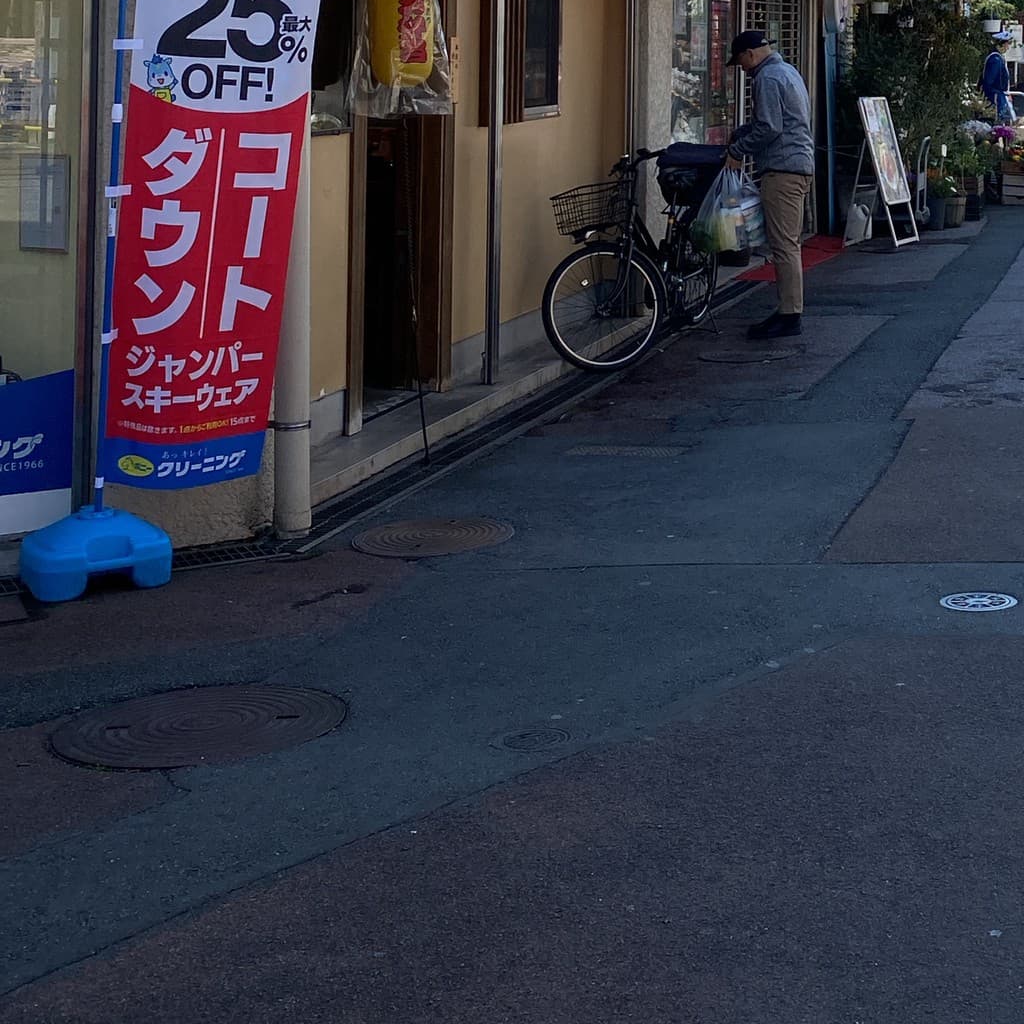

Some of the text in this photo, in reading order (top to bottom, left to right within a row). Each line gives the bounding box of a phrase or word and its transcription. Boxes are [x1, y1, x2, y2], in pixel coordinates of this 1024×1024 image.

[281, 15, 313, 34] 最大
[181, 63, 275, 103] OFF!
[131, 127, 213, 336] ダウン
[218, 131, 293, 333] コート
[125, 340, 264, 384] ジャンパー
[120, 377, 260, 414] スキーウェア
[157, 449, 247, 478] クリーニング
